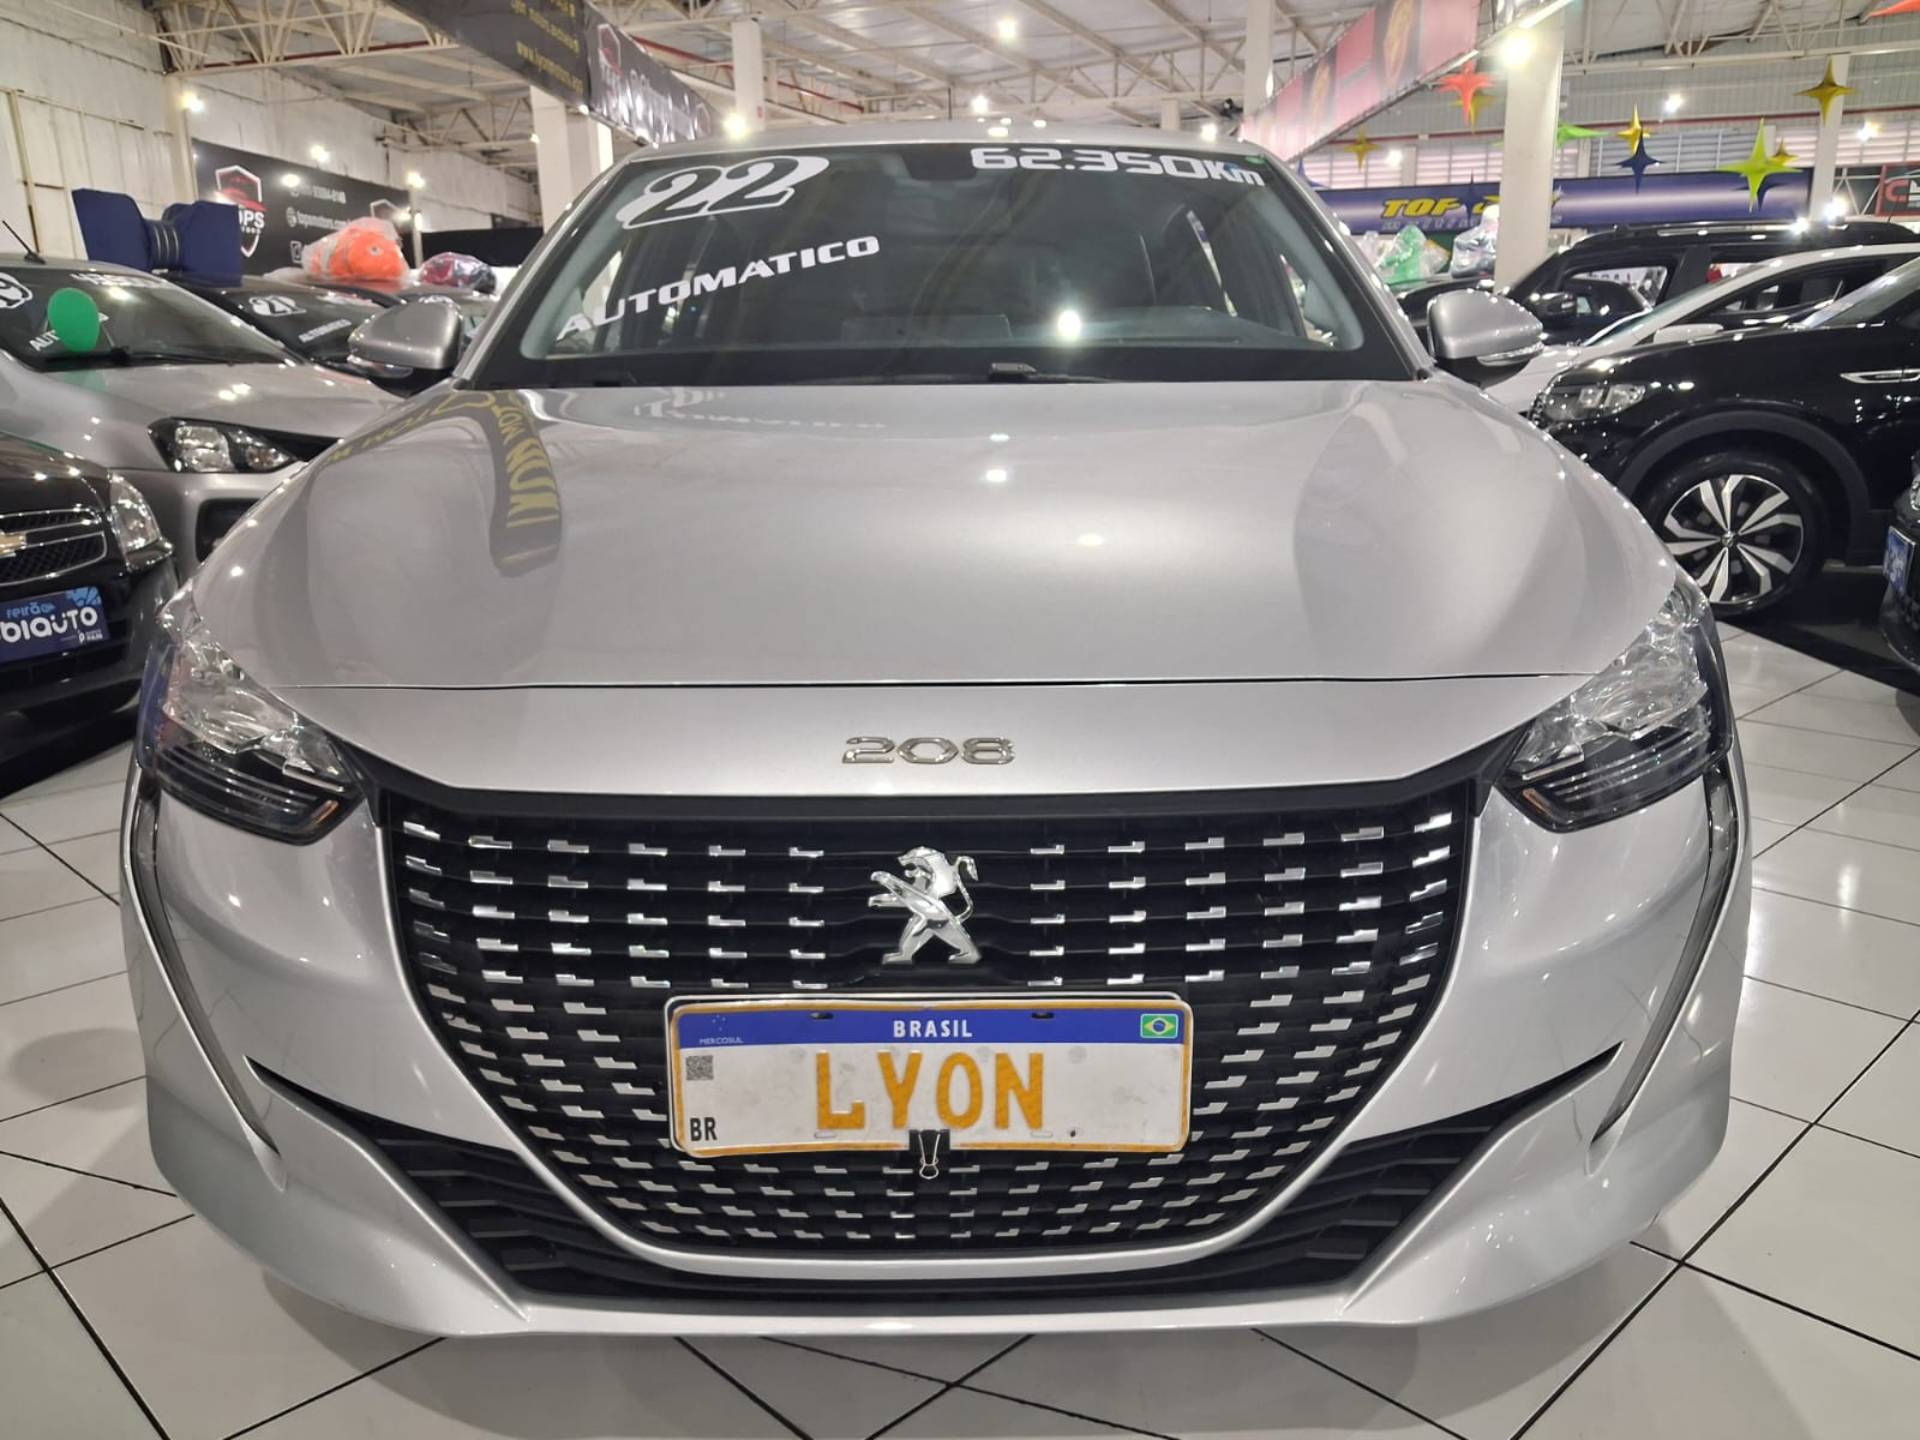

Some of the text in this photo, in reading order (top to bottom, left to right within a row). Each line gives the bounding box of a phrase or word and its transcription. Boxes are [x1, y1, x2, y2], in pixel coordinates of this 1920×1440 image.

[616, 155, 830, 230] 22
[555, 235, 881, 342] AUTOMATICO
[842, 736, 1015, 765] 208
[699, 1036, 744, 1045] MERCOSUL
[893, 1020, 973, 1038] BRASIL
[816, 1050, 1044, 1129] LYON
[690, 1117, 717, 1141] BR
